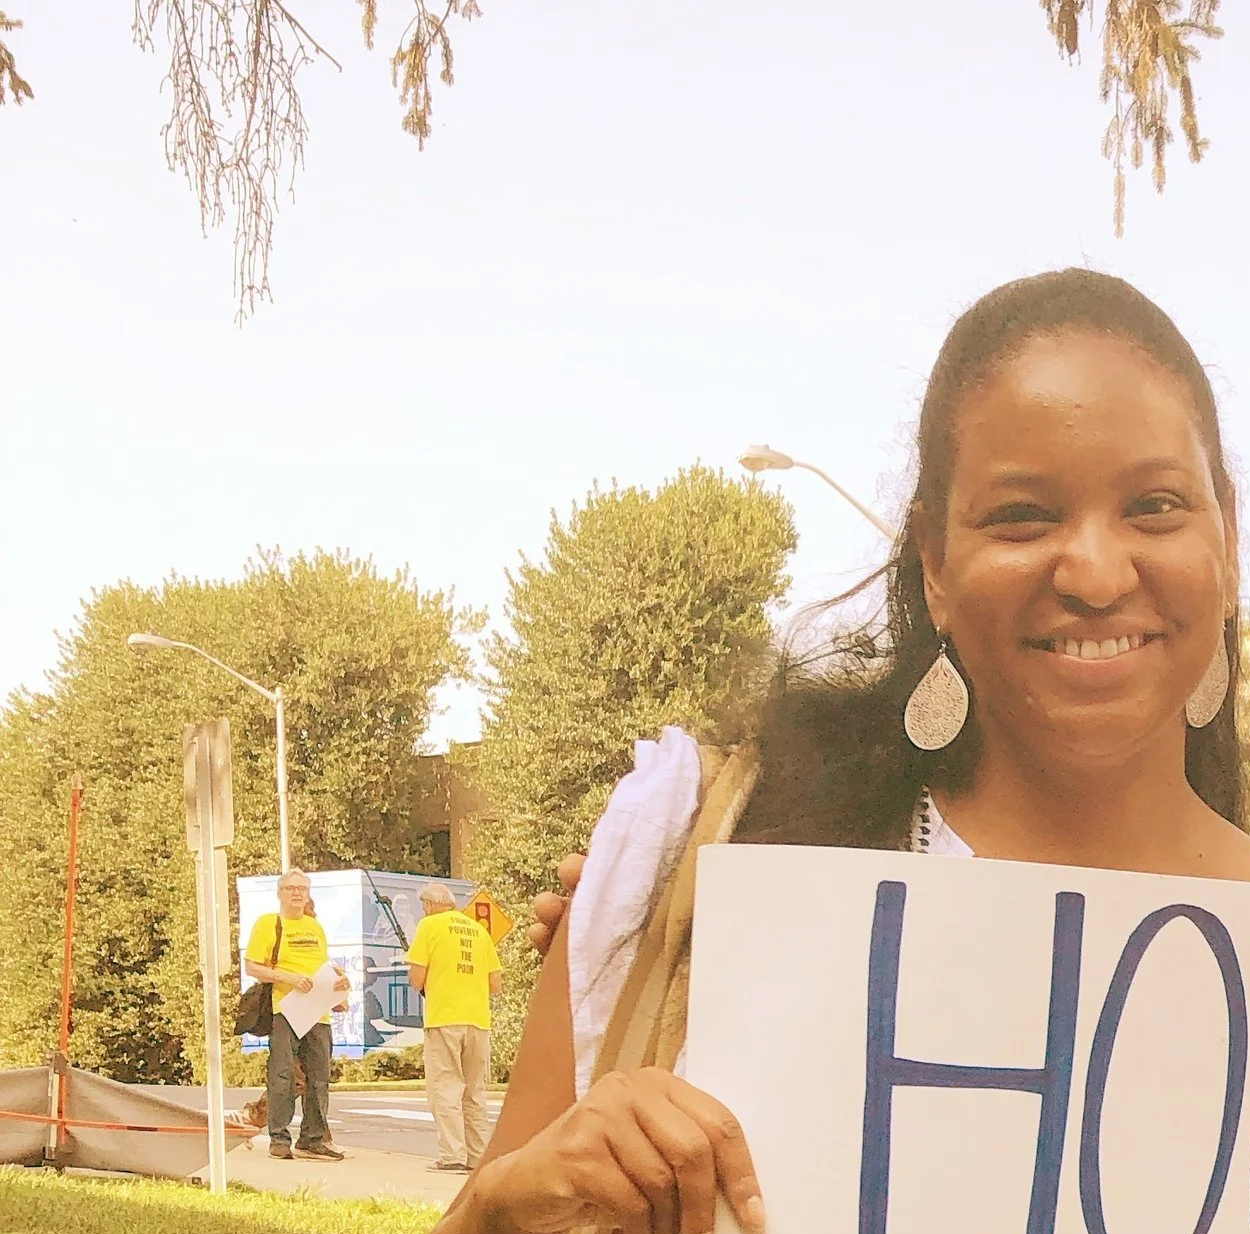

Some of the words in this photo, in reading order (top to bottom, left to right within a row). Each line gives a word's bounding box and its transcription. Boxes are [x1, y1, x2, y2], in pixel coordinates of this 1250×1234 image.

[448, 925, 479, 938] POVERTY
[460, 938, 472, 949] NOT
[460, 950, 472, 962] THE
[456, 962, 474, 975] POOR
